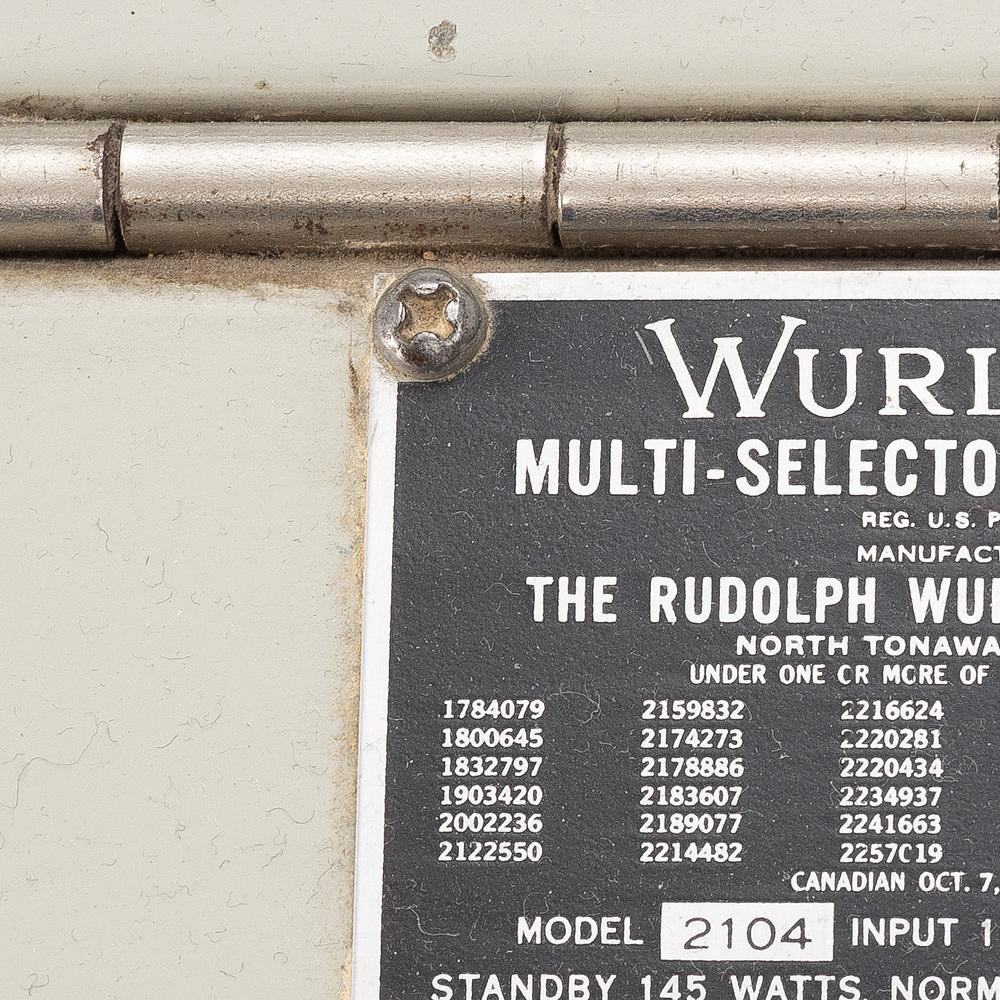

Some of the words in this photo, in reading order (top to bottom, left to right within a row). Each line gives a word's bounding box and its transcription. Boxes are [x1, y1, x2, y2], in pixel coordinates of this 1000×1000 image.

[861, 510, 916, 529] REG.
[928, 511, 976, 529] U.S.
[525, 575, 618, 623] THE
[649, 576, 877, 626] RUDOLPH
[736, 634, 849, 656] NORTH
[689, 663, 767, 685] UNDER
[778, 663, 826, 685] ONE
[959, 664, 990, 685] OF
[443, 698, 546, 720] 1784079
[641, 698, 745, 721] 2159832
[441, 727, 544, 749] 1800645
[640, 727, 743, 749] 2174273
[441, 755, 543, 777] 1832797
[640, 756, 745, 778] 2178886
[840, 756, 945, 780] 2220434
[440, 784, 543, 806] 1903420
[639, 785, 743, 807] 2183607
[839, 786, 942, 807] 2234937
[438, 812, 544, 833] 2002236
[639, 812, 743, 834] 2189077
[838, 813, 942, 835] 2241663
[437, 840, 543, 862] 2122550
[639, 841, 743, 863] 2214482
[790, 870, 906, 893] CANADIAN
[918, 871, 971, 893] OCT.
[979, 871, 1000, 896] 7,
[517, 914, 644, 945] MODEL
[684, 917, 812, 950] 2104
[851, 917, 959, 947] INPUT
